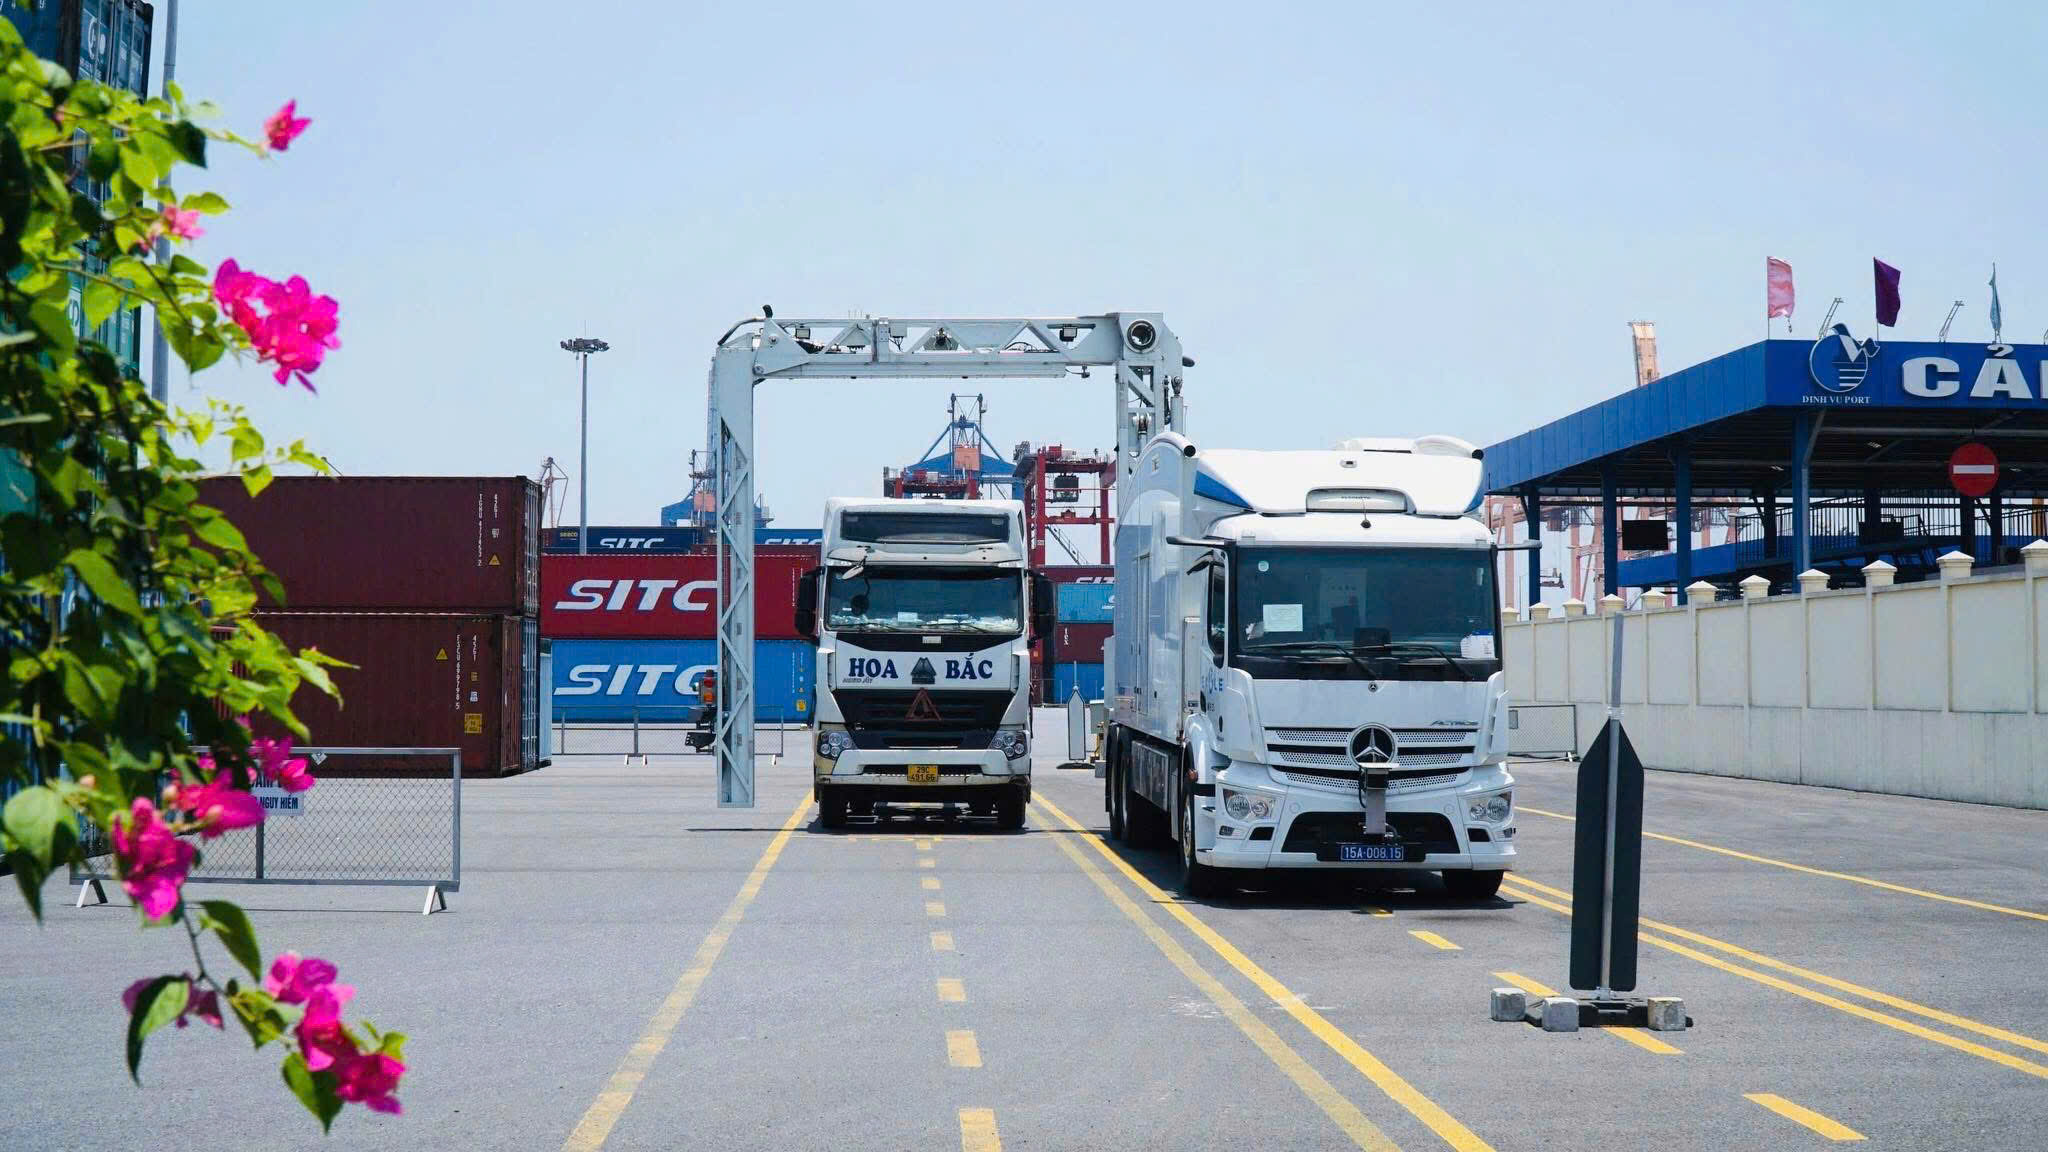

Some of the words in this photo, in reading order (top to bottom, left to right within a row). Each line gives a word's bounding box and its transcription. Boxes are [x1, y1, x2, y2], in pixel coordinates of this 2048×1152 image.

[1902, 344, 2048, 399] CẢ
[1802, 395, 1827, 404] DINH
[1844, 395, 1871, 405] PORT
[600, 537, 664, 549] SITC
[554, 579, 718, 612] SITC
[553, 664, 718, 696] SITC
[848, 657, 899, 679] HOA
[945, 652, 993, 680] BẮC
